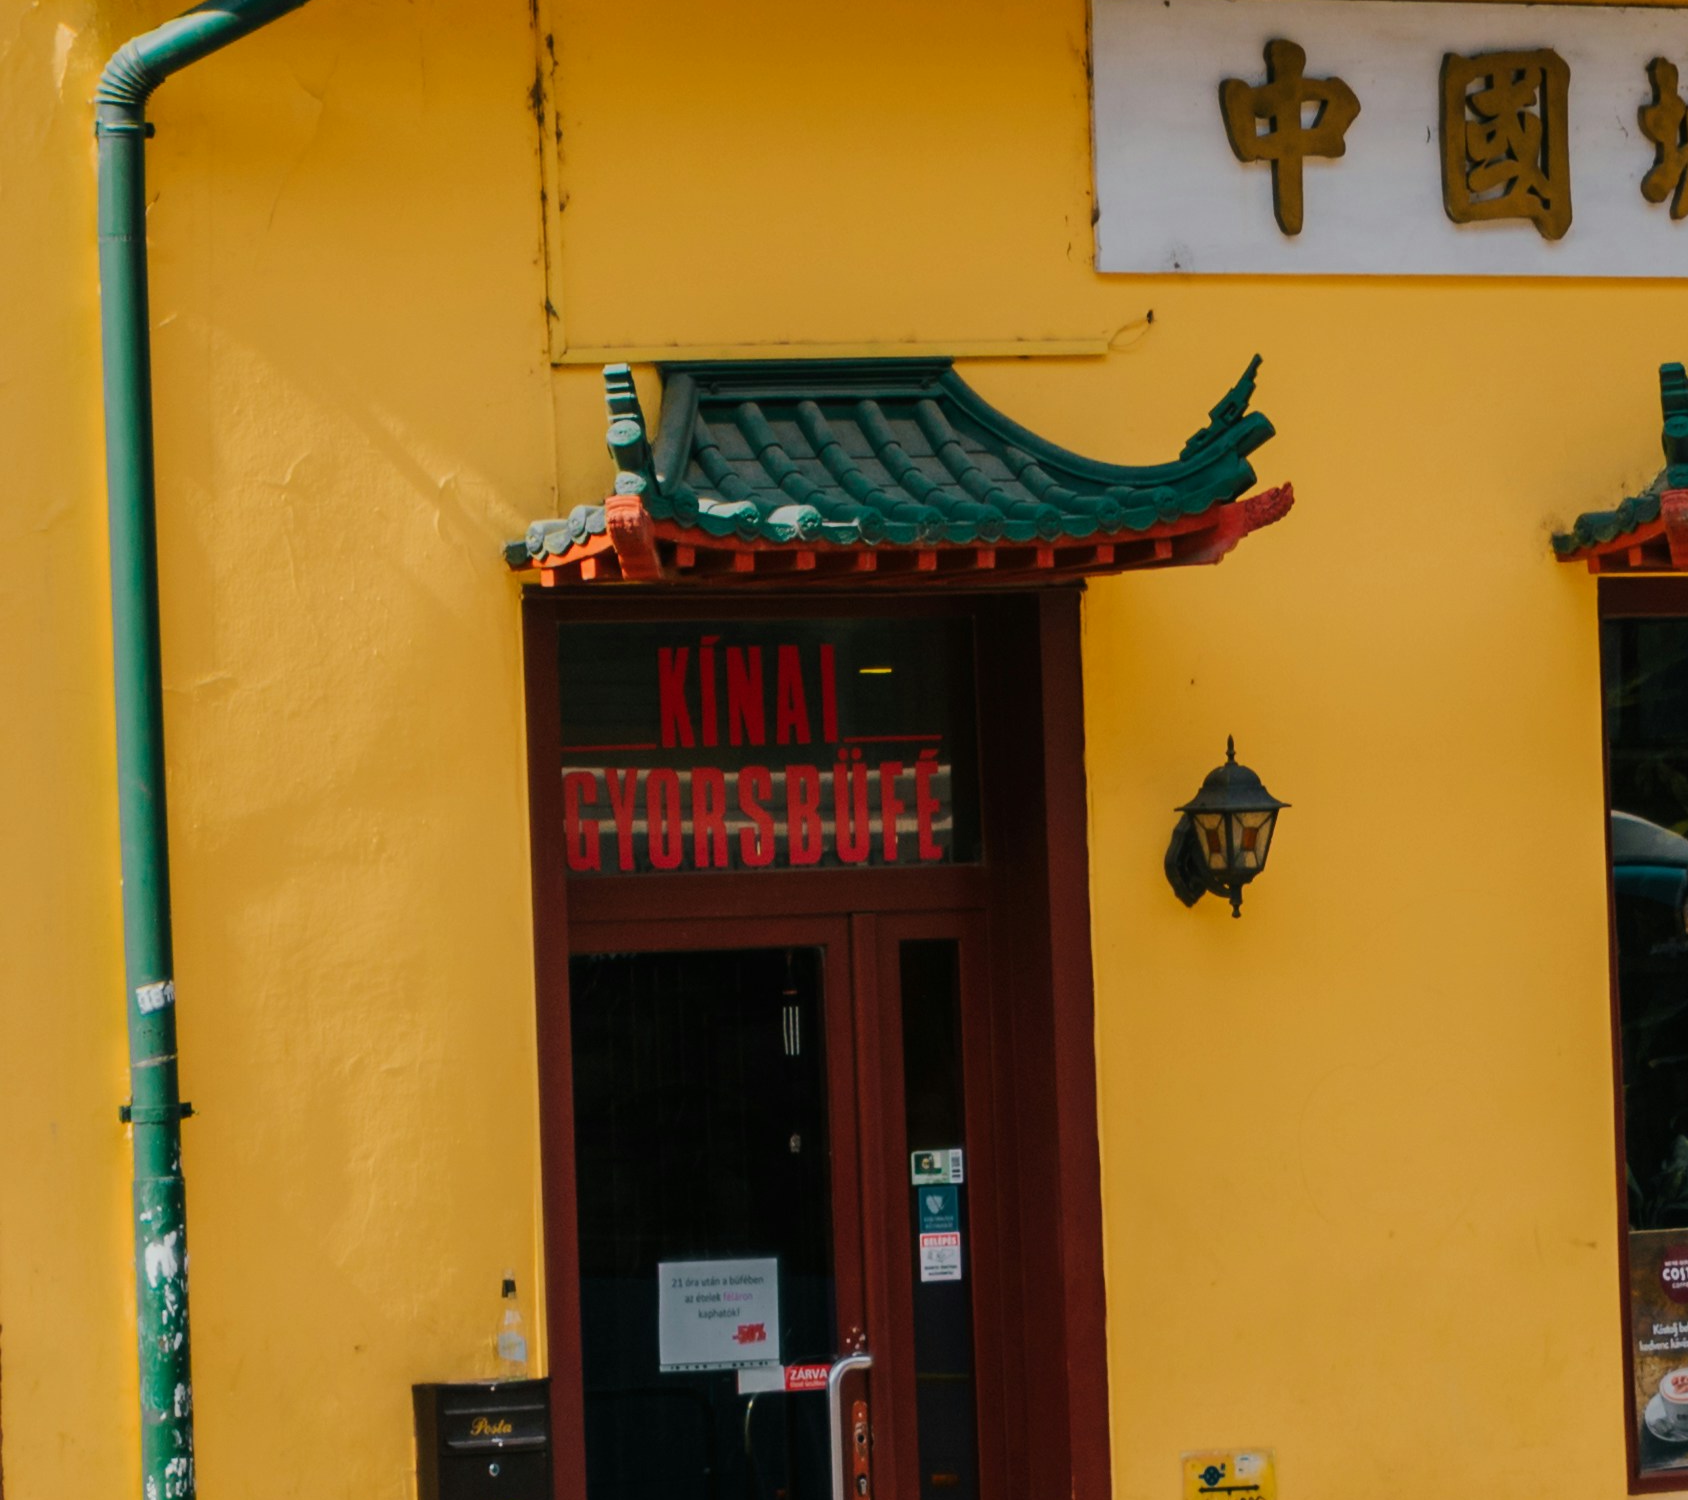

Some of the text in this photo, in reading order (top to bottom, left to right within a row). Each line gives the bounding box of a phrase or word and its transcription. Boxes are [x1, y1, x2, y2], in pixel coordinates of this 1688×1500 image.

[657, 635, 839, 749] KÍNAI
[563, 747, 944, 872] GYORSBÜFÉ
[671, 1278, 683, 1288] 21
[685, 1277, 699, 1287] óra
[701, 1276, 720, 1287] után
[729, 1274, 764, 1286] büfében
[790, 1367, 828, 1380] ZÁRVA
[470, 1416, 512, 1436] Posta
